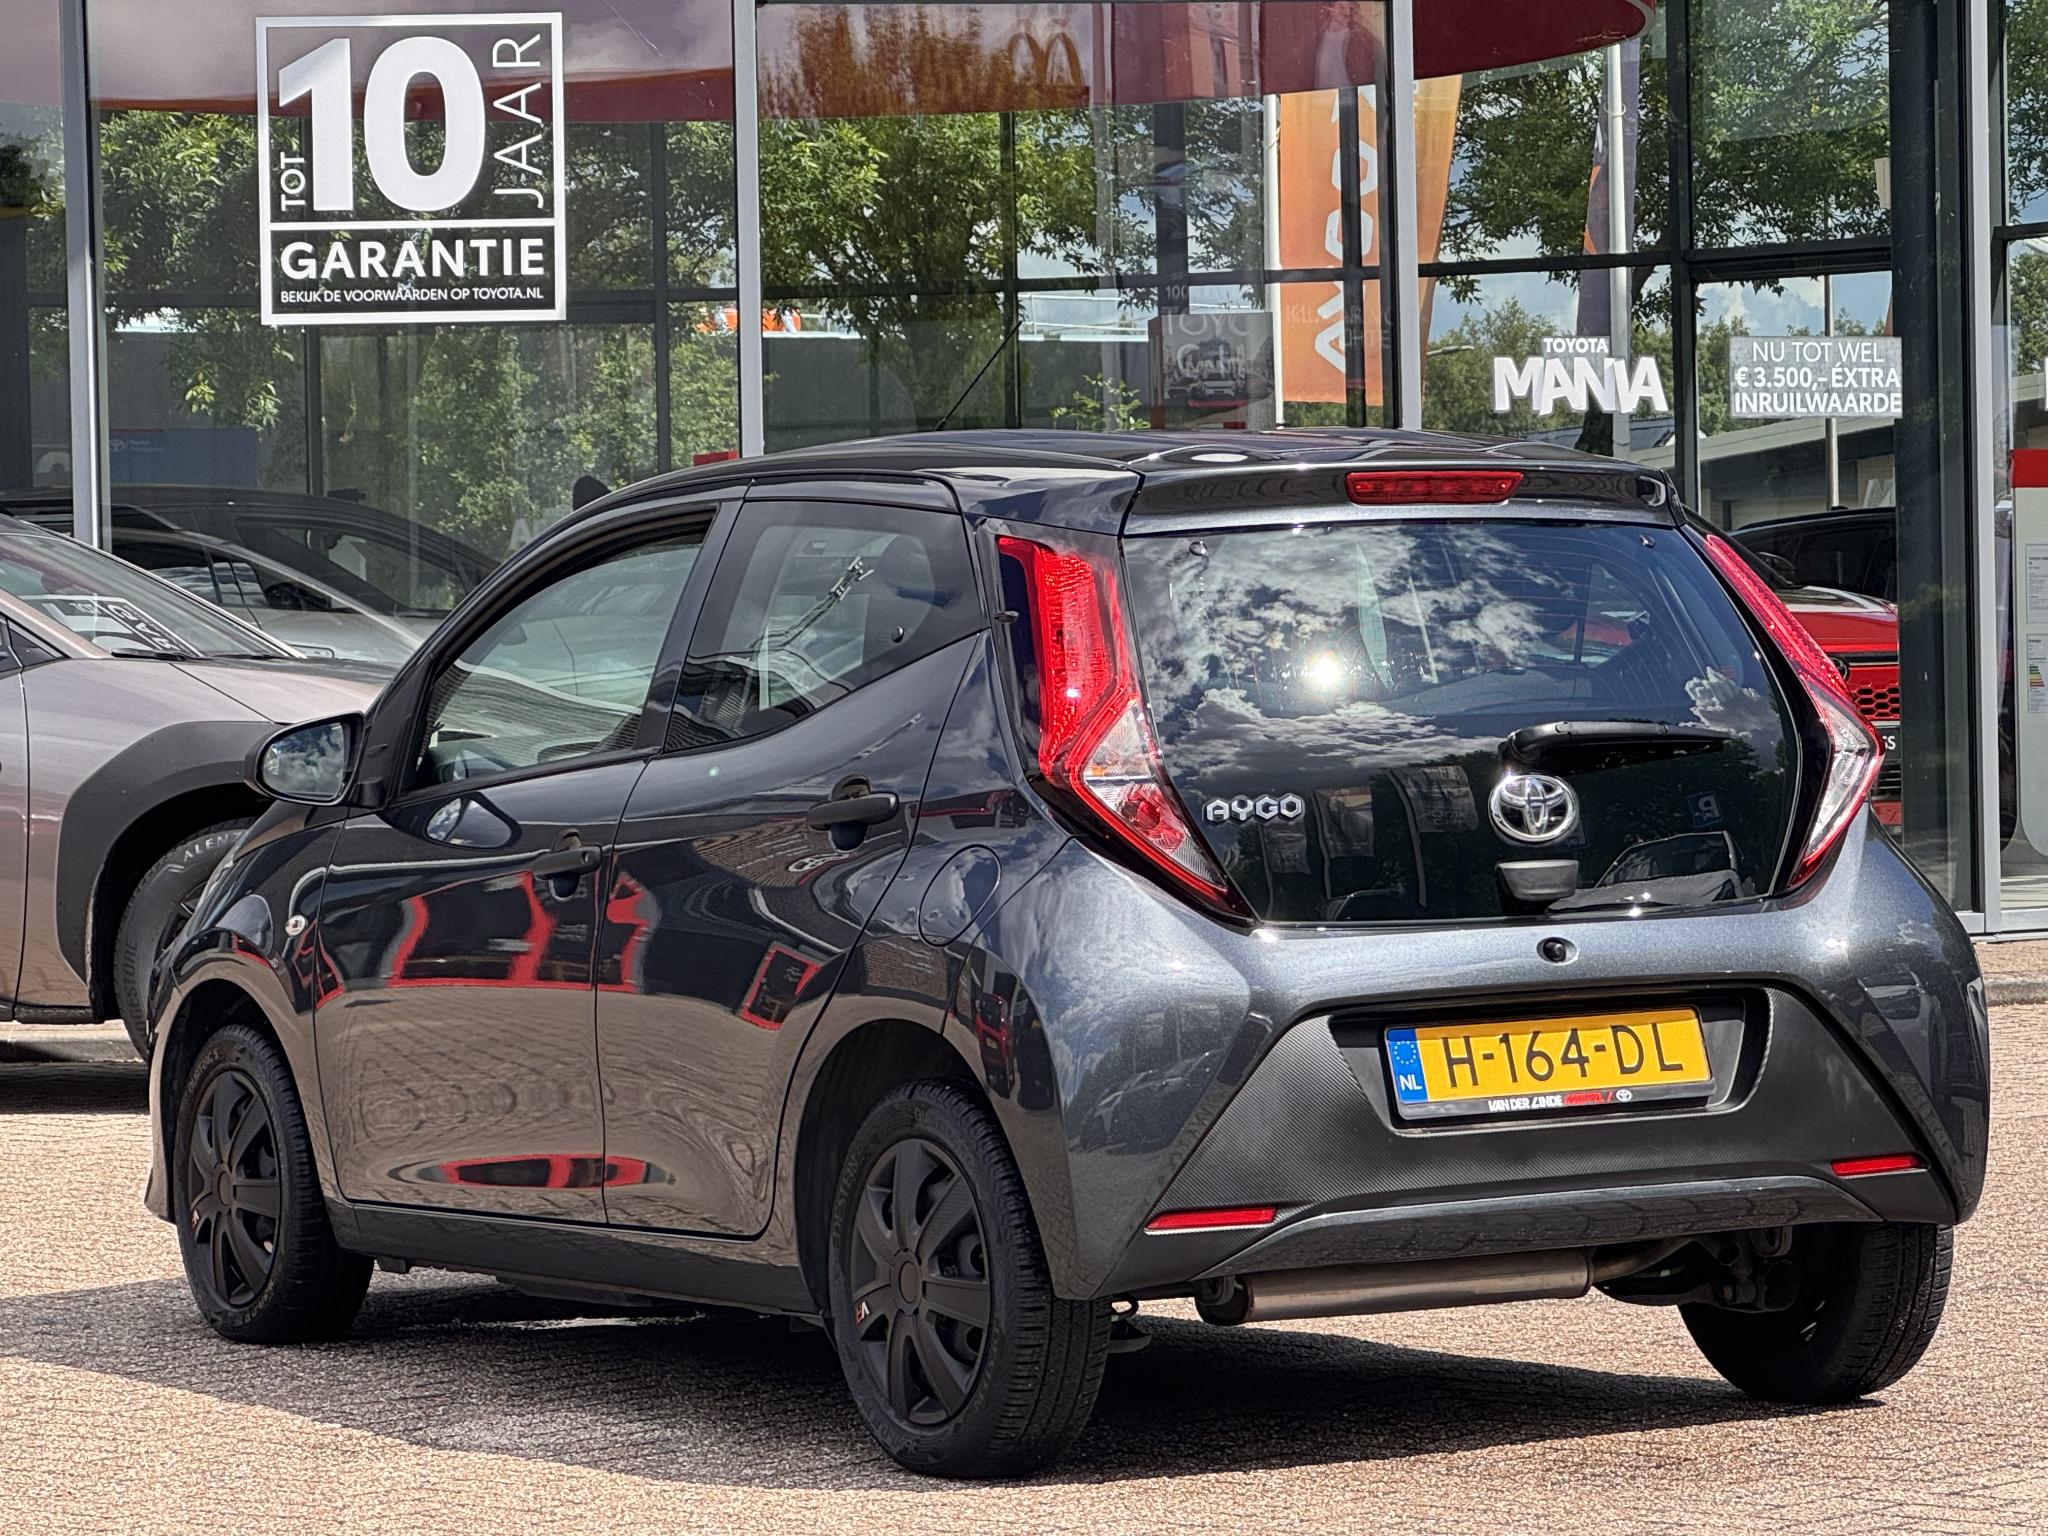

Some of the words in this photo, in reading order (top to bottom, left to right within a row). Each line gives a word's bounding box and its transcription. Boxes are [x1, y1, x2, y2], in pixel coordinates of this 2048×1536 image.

[278, 36, 486, 212] 10
[493, 33, 545, 209] JAAR
[280, 151, 306, 212] TOT
[280, 238, 545, 280] GARANTIE
[280, 290, 321, 303] BEKIJK
[323, 289, 342, 302] DE
[343, 287, 448, 302] VOORWAARDEN
[450, 287, 471, 300] OP
[472, 286, 544, 299] TOYOTA.NL
[1543, 337, 1609, 353] TOYOTA
[1752, 342, 1785, 362] NU
[1791, 341, 1833, 362] TOT
[1838, 341, 1884, 363] WEL
[1493, 356, 1669, 416] MANIA
[1734, 366, 1749, 388] €
[1734, 392, 1902, 414] INRUILWAARDE
[1205, 794, 1303, 821] AYGO
[1442, 1021, 1684, 1088] H-164-DL
[1399, 1074, 1423, 1092] NL
[1488, 1098, 1510, 1112] VAN
[1510, 1096, 1530, 1110] DER
